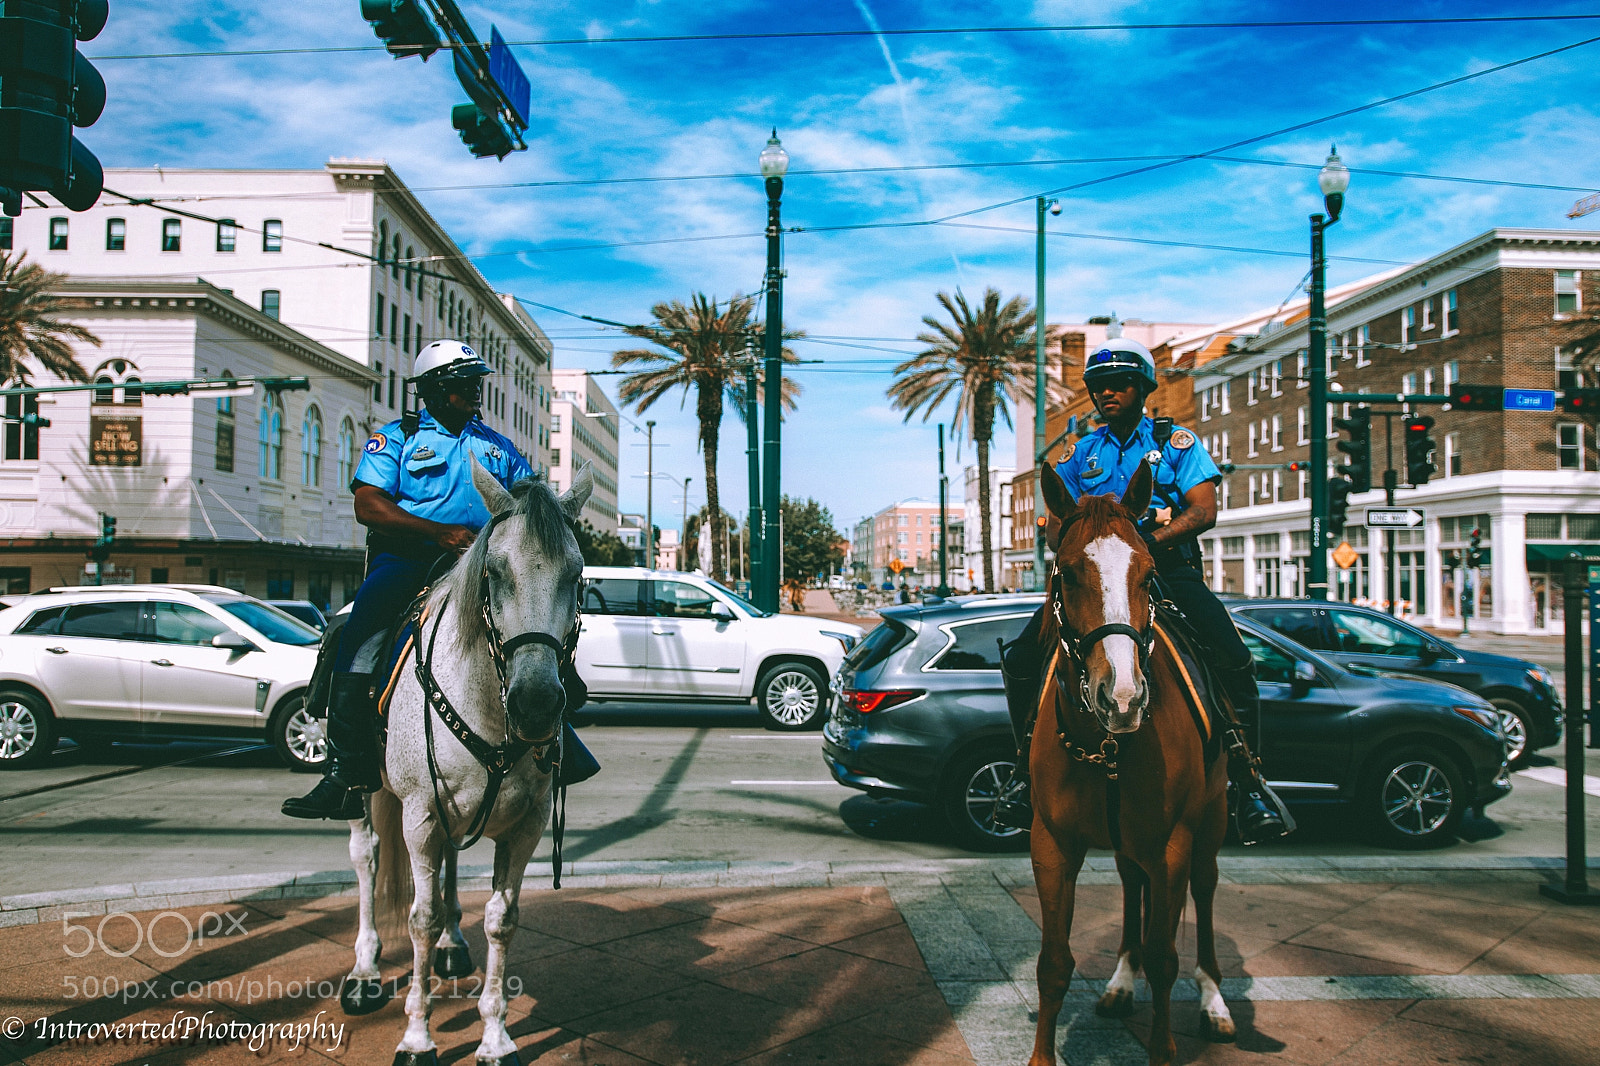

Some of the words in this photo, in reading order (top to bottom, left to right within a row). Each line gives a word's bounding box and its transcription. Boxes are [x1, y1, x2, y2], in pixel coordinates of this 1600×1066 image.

[1516, 394, 1543, 406] Canal
[101, 431, 132, 441] NOW
[1371, 512, 1388, 524] ONE
[1390, 512, 1407, 524] WAY
[439, 702, 469, 740] DEDE
